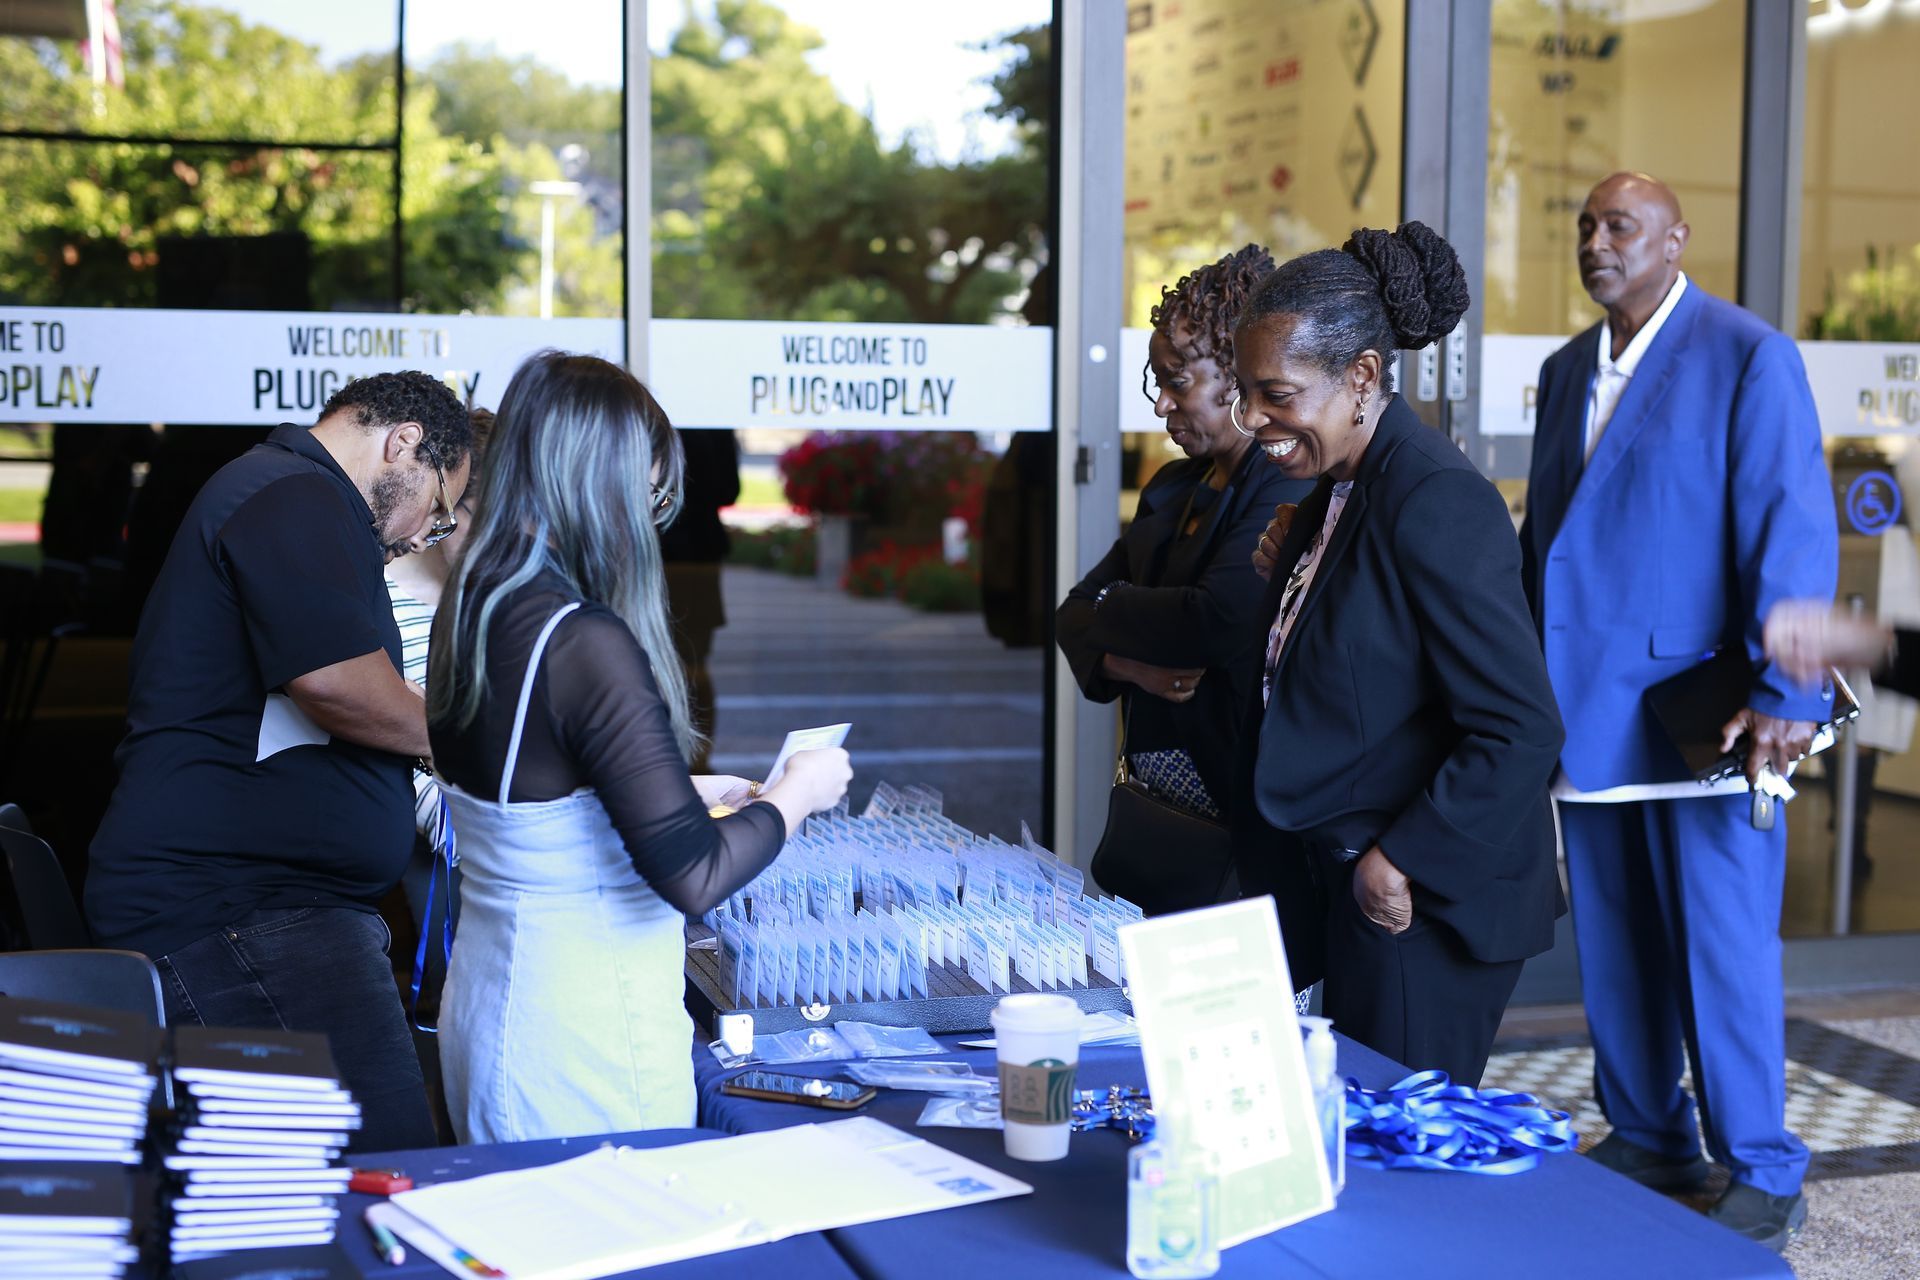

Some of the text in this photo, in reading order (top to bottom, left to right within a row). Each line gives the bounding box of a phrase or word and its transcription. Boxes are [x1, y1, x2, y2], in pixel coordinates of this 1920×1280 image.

[31, 321, 64, 353] TO
[288, 326, 449, 357] WELCOME TO
[783, 336, 927, 366] WELCOME TO
[751, 375, 954, 416] PLUGANDPLAY
